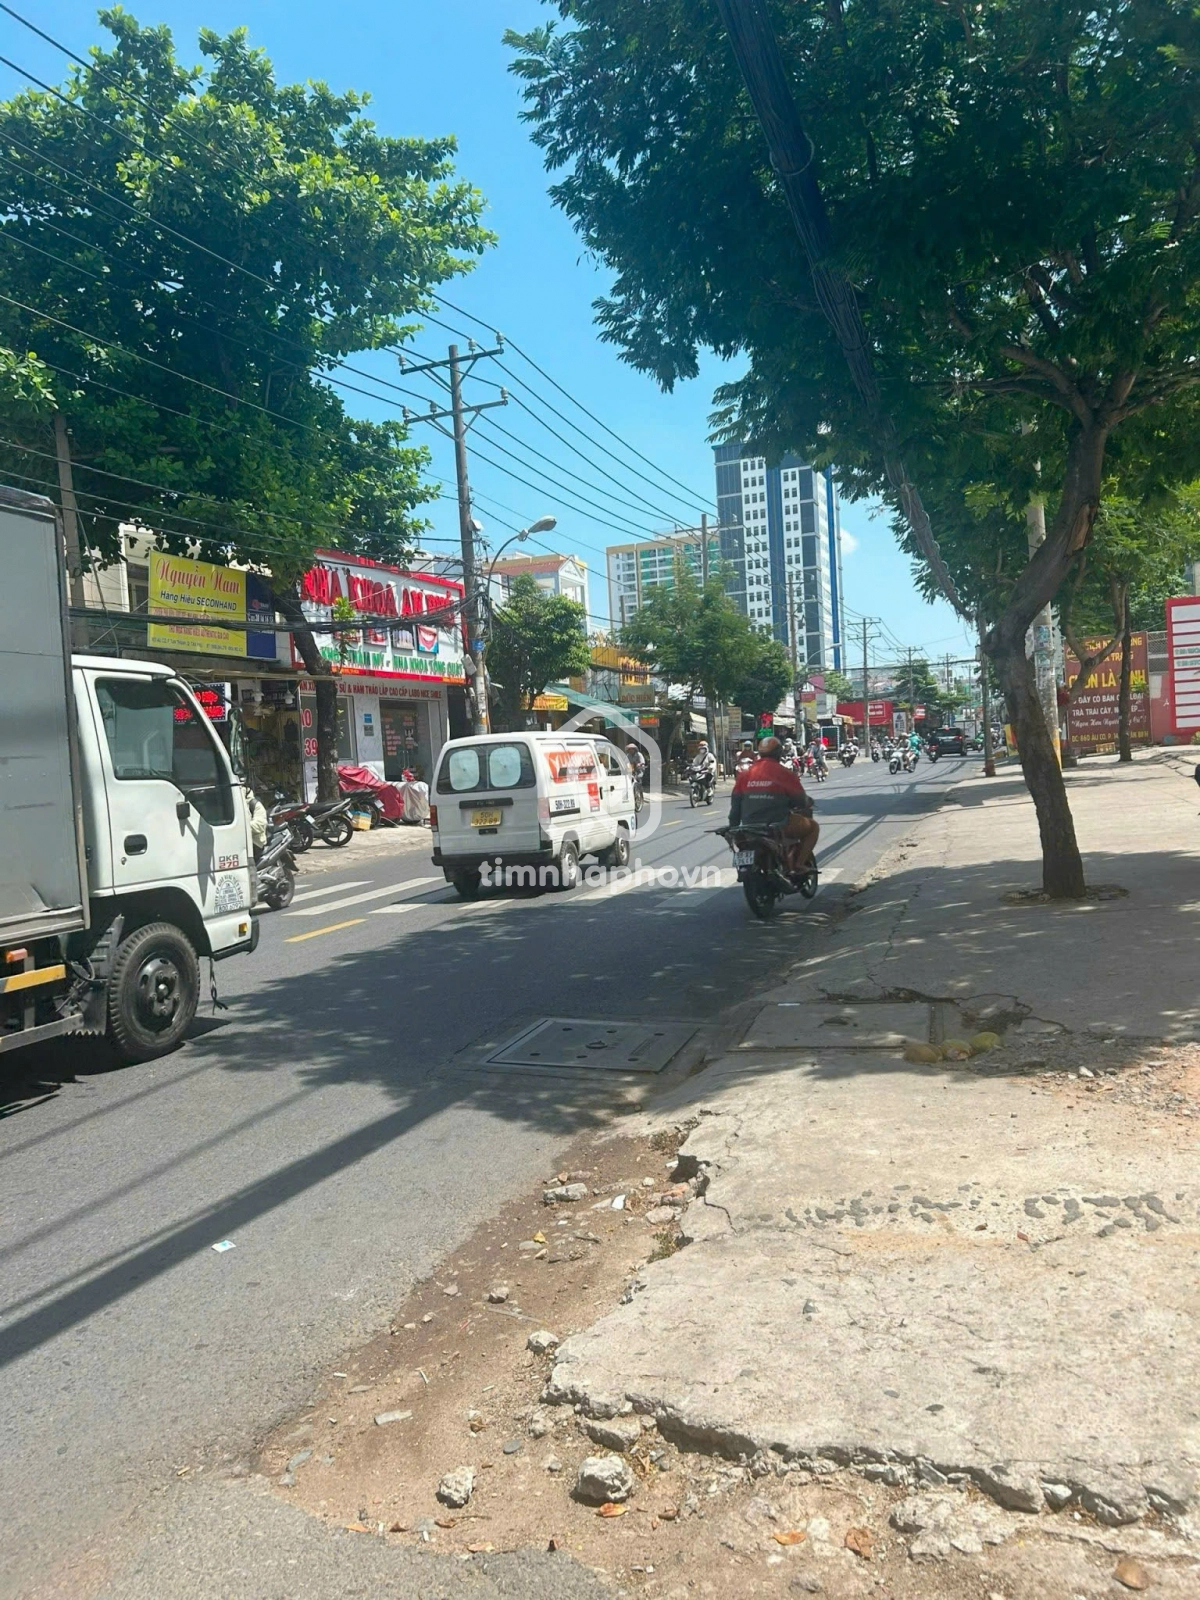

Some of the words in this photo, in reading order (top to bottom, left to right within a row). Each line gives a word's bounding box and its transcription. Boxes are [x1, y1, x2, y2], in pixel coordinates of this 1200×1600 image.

[211, 569, 240, 594] Nam
[196, 596, 237, 611] SECONHAND
[393, 655, 408, 672] NHA
[409, 657, 428, 674] KHOA
[1102, 668, 1116, 688] LÀ
[219, 854, 239, 863] QKR
[219, 860, 240, 870] 270
